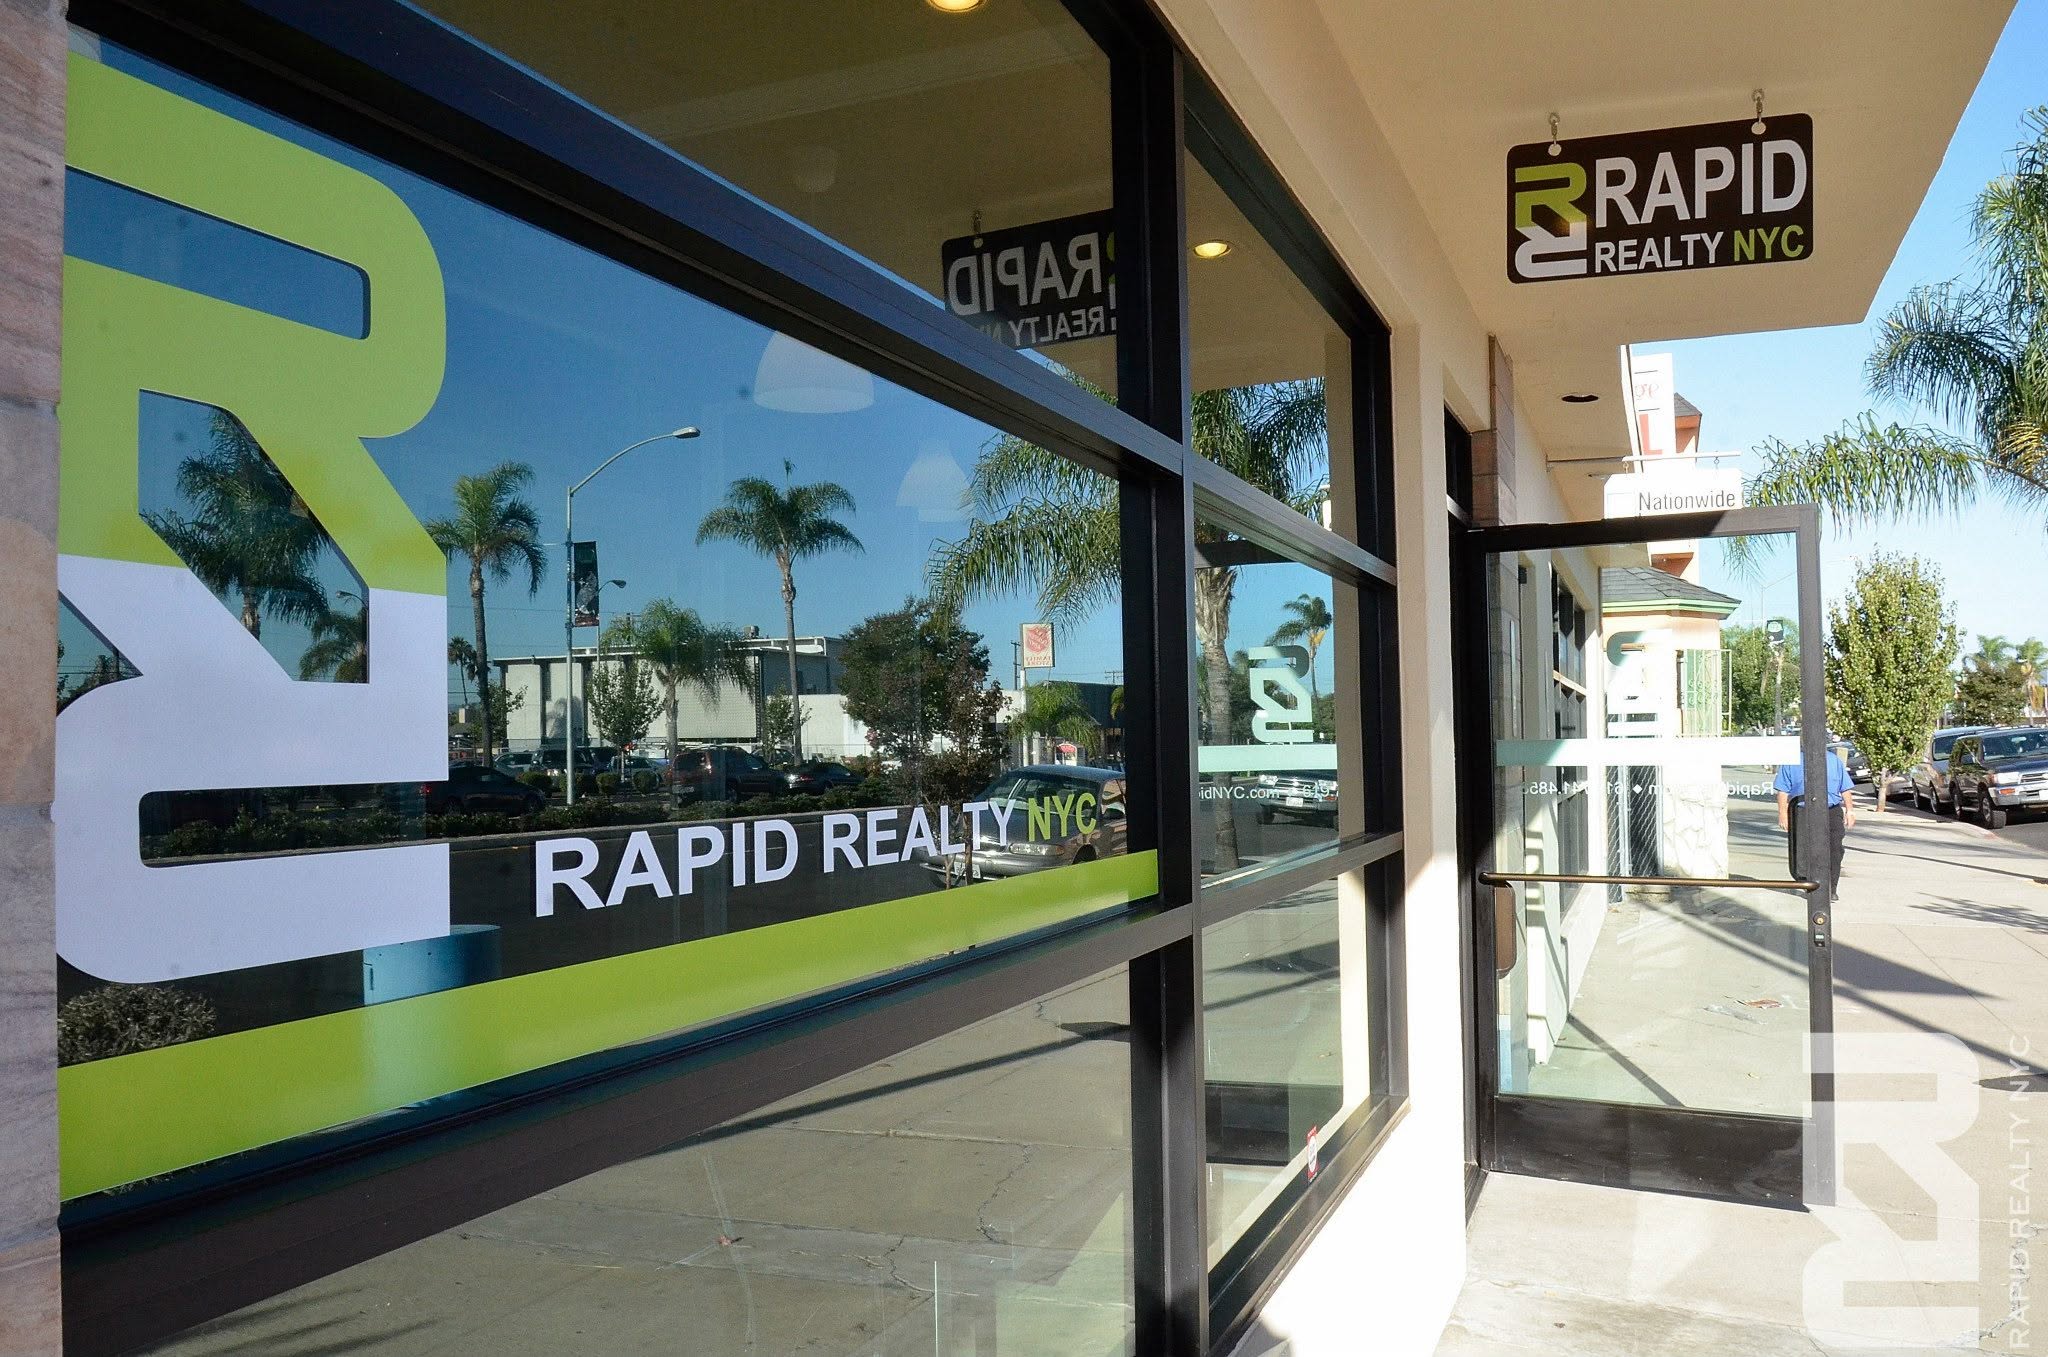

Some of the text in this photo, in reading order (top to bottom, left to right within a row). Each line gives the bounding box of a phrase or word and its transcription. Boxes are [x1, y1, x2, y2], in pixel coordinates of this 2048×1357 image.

[1595, 139, 1807, 229] RAPID
[1595, 225, 1804, 273] REALTY NYC
[1638, 490, 1736, 511] Nationwide
[1199, 785, 1280, 800] idNYC.com
[534, 792, 1097, 918] RAPID REALTY NYC
